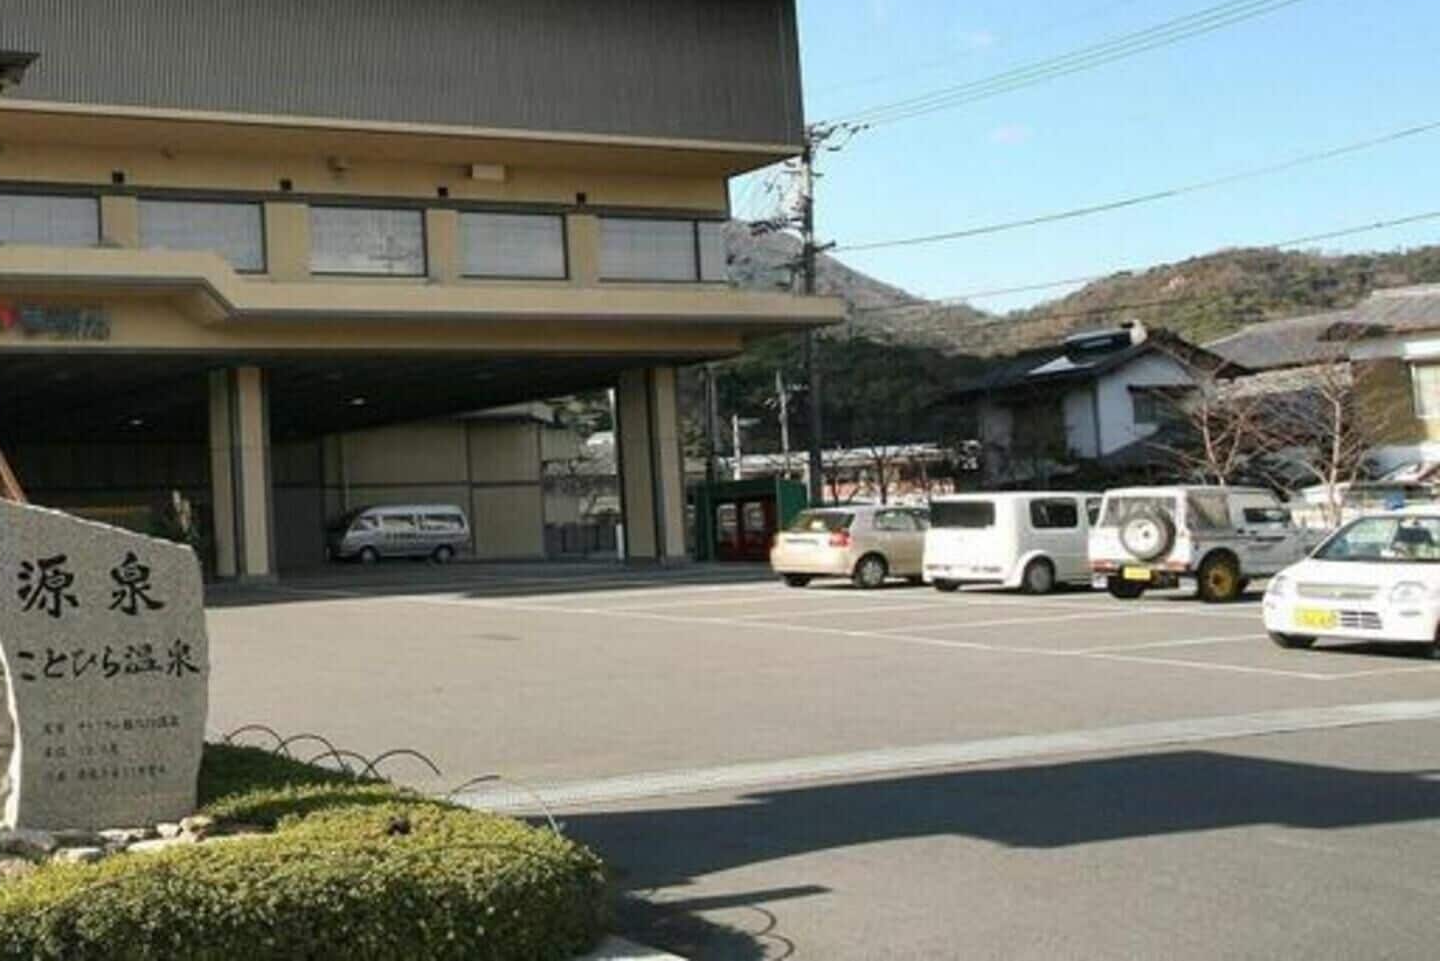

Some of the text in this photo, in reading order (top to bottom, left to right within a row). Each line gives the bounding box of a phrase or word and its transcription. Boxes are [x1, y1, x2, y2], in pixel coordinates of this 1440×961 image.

[17, 551, 165, 618] 源泉
[17, 638, 201, 681] ことひら温泉
